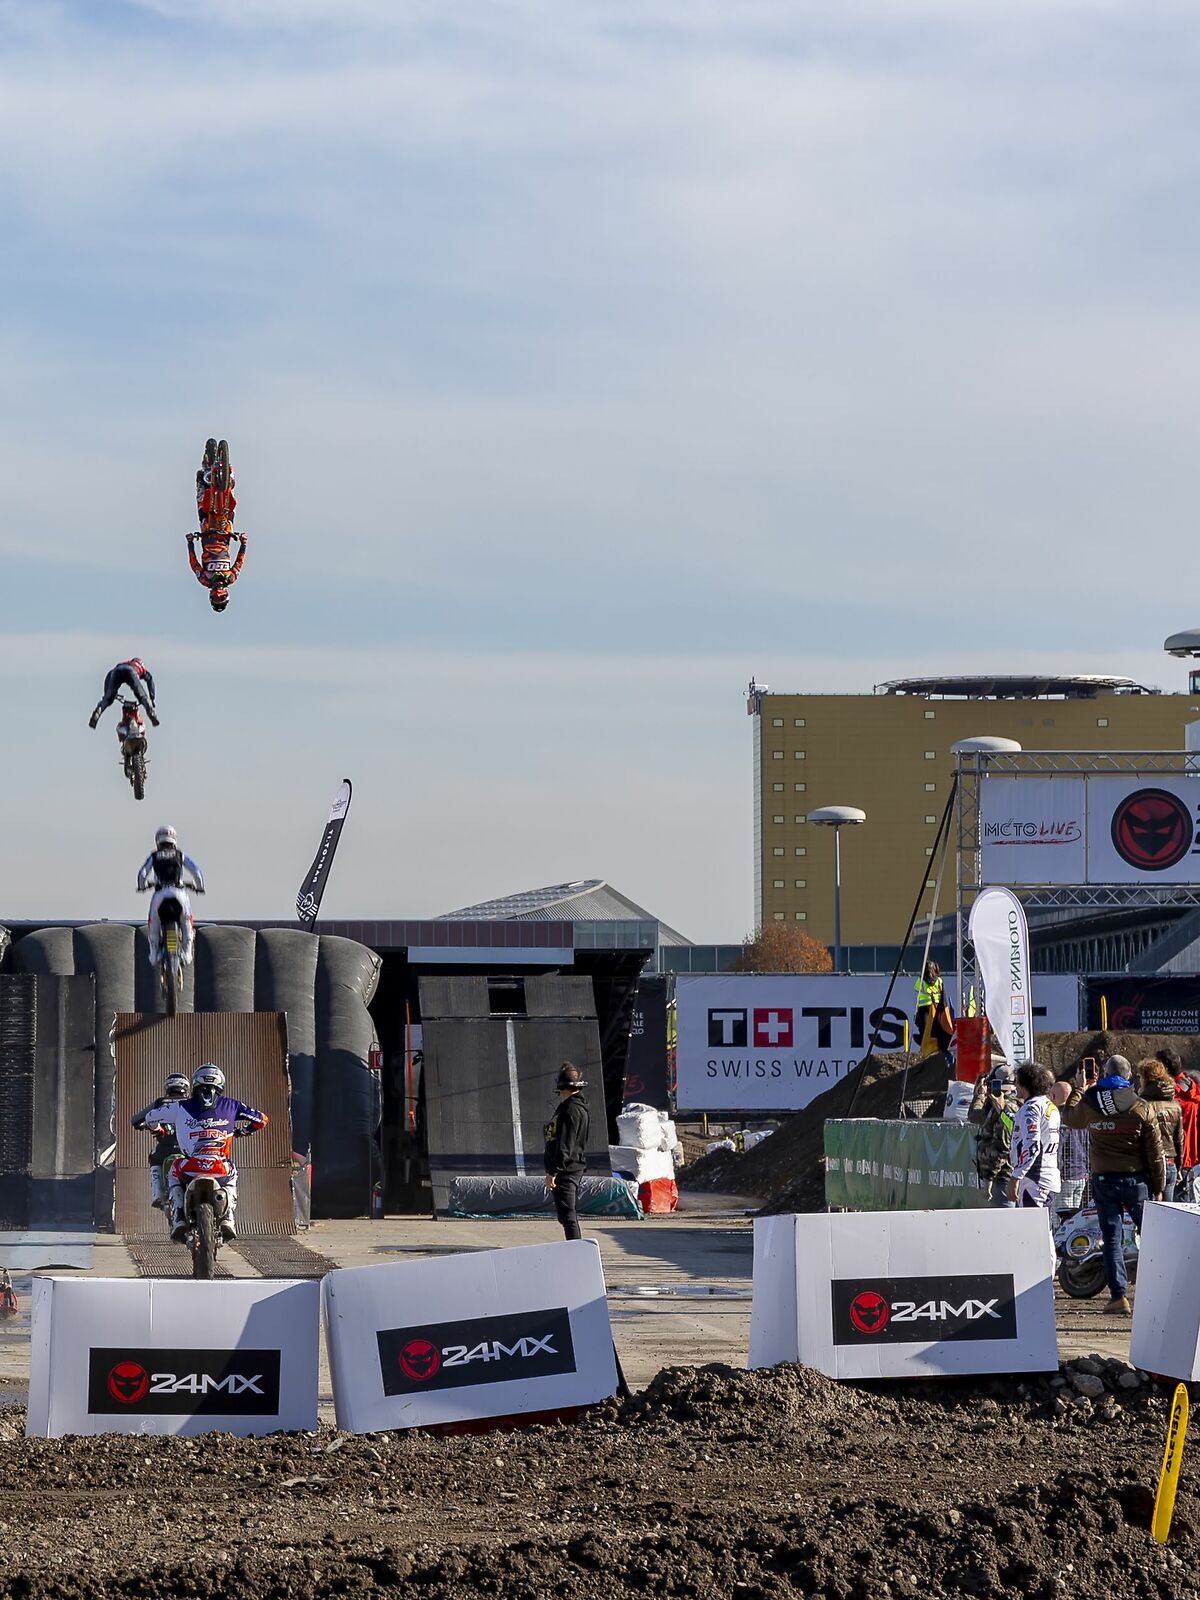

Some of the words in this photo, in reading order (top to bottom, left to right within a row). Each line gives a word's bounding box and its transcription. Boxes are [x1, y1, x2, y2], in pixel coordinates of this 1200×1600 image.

[1039, 821, 1077, 836] LIVE
[706, 1060, 782, 1078] SWISS
[890, 1298, 1002, 1322] 24MX
[441, 1334, 558, 1367] 24MX
[149, 1373, 265, 1394] 24MX
